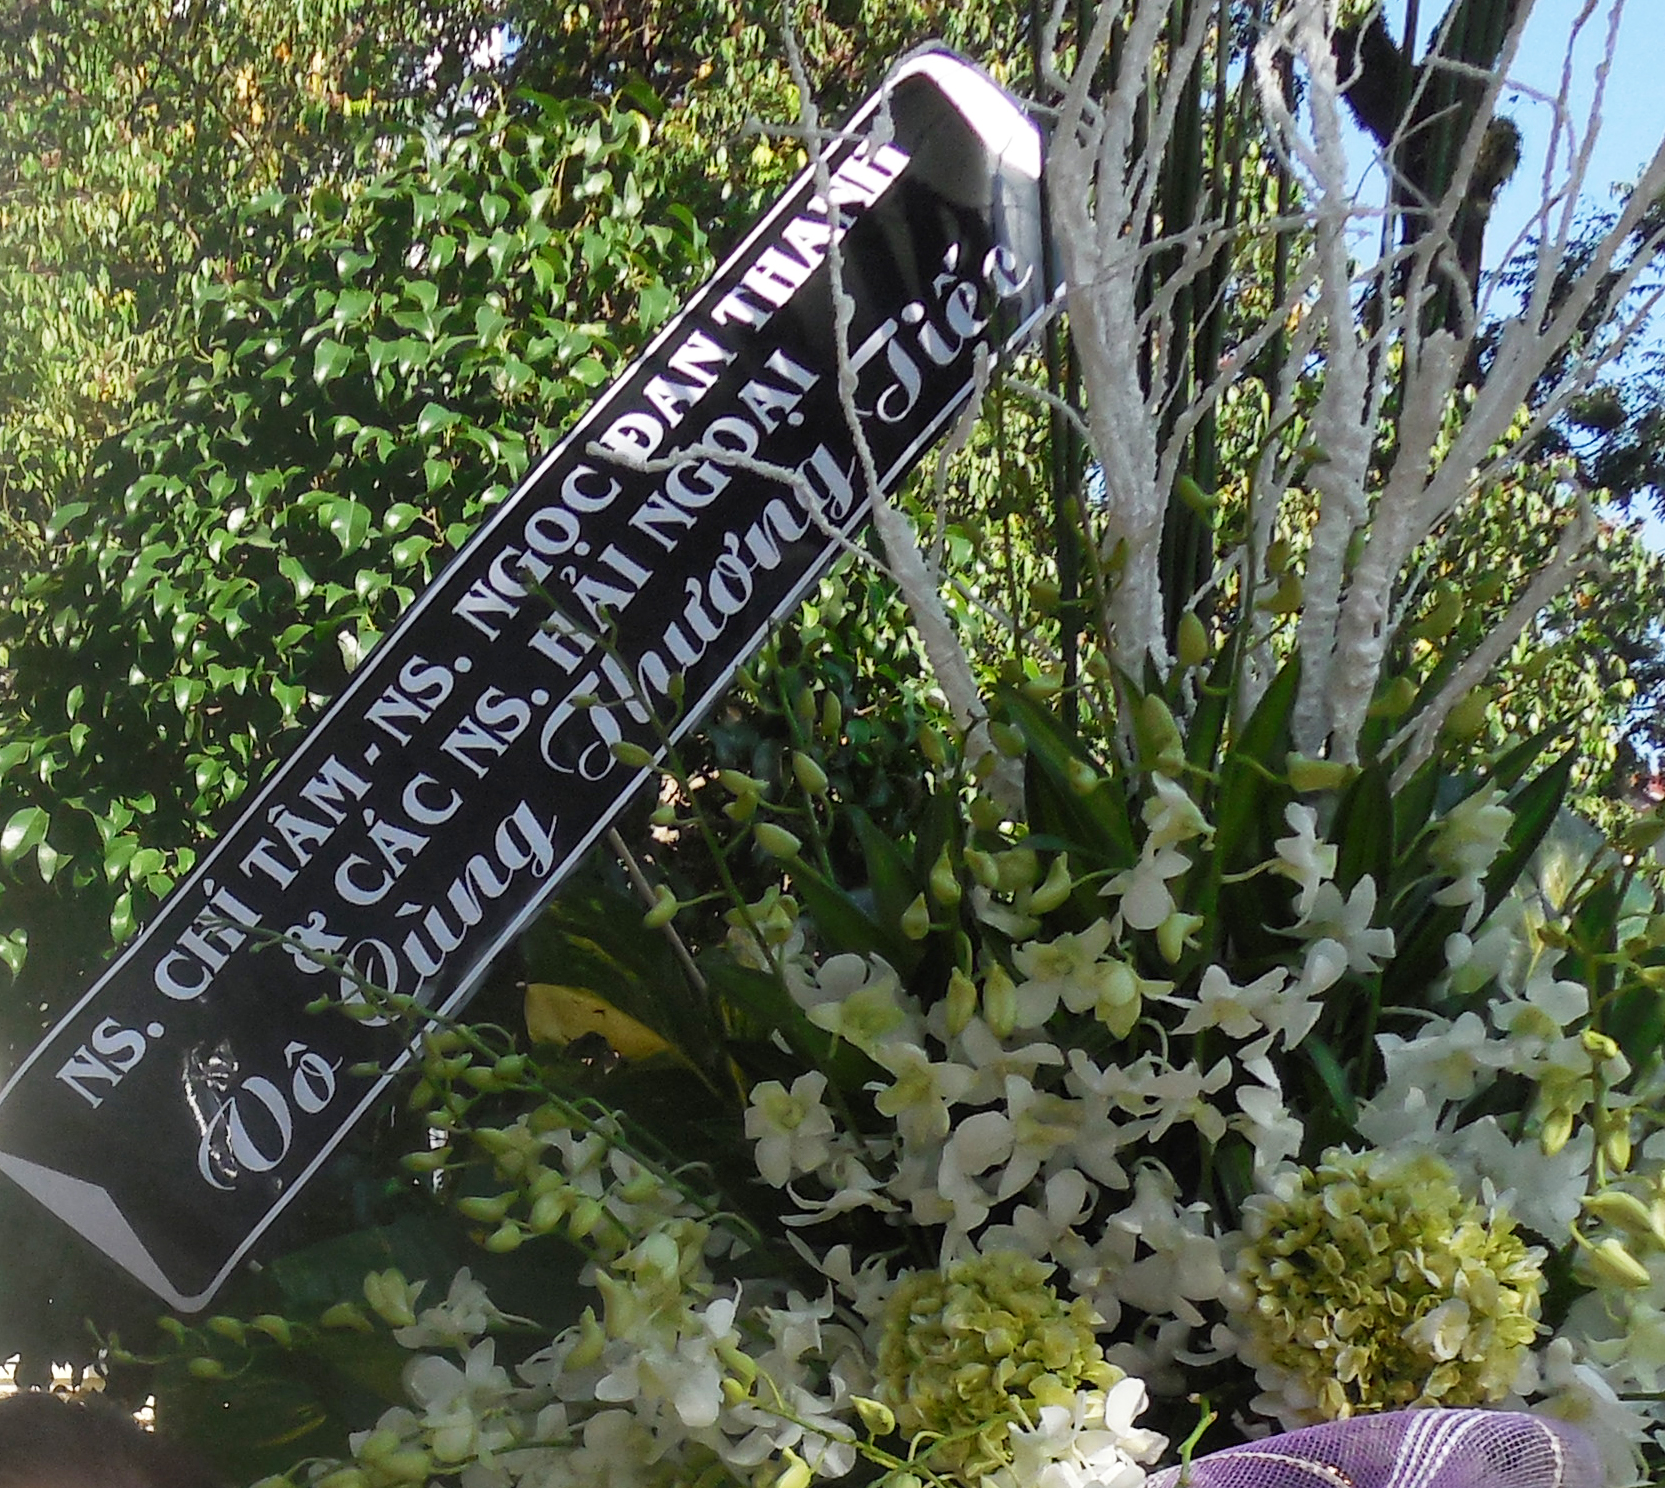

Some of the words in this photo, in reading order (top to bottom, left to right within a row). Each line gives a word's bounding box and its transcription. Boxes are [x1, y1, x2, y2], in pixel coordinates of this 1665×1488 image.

[55, 1016, 165, 1109] NS.
[154, 878, 262, 1000] CHÍ
[451, 464, 622, 642] NGỌC
[600, 328, 738, 461] ĐAN
[710, 135, 911, 331] THANH
[199, 1041, 343, 1190] Vô
[340, 800, 557, 1027] Cùng
[540, 443, 855, 781] Thương
[844, 244, 1034, 421] Tiếc
[282, 911, 348, 973] &
[334, 772, 463, 905] CÁC
[439, 685, 549, 779] NS.
[528, 544, 653, 675] HẢI
[628, 349, 820, 552] NGOẠI
